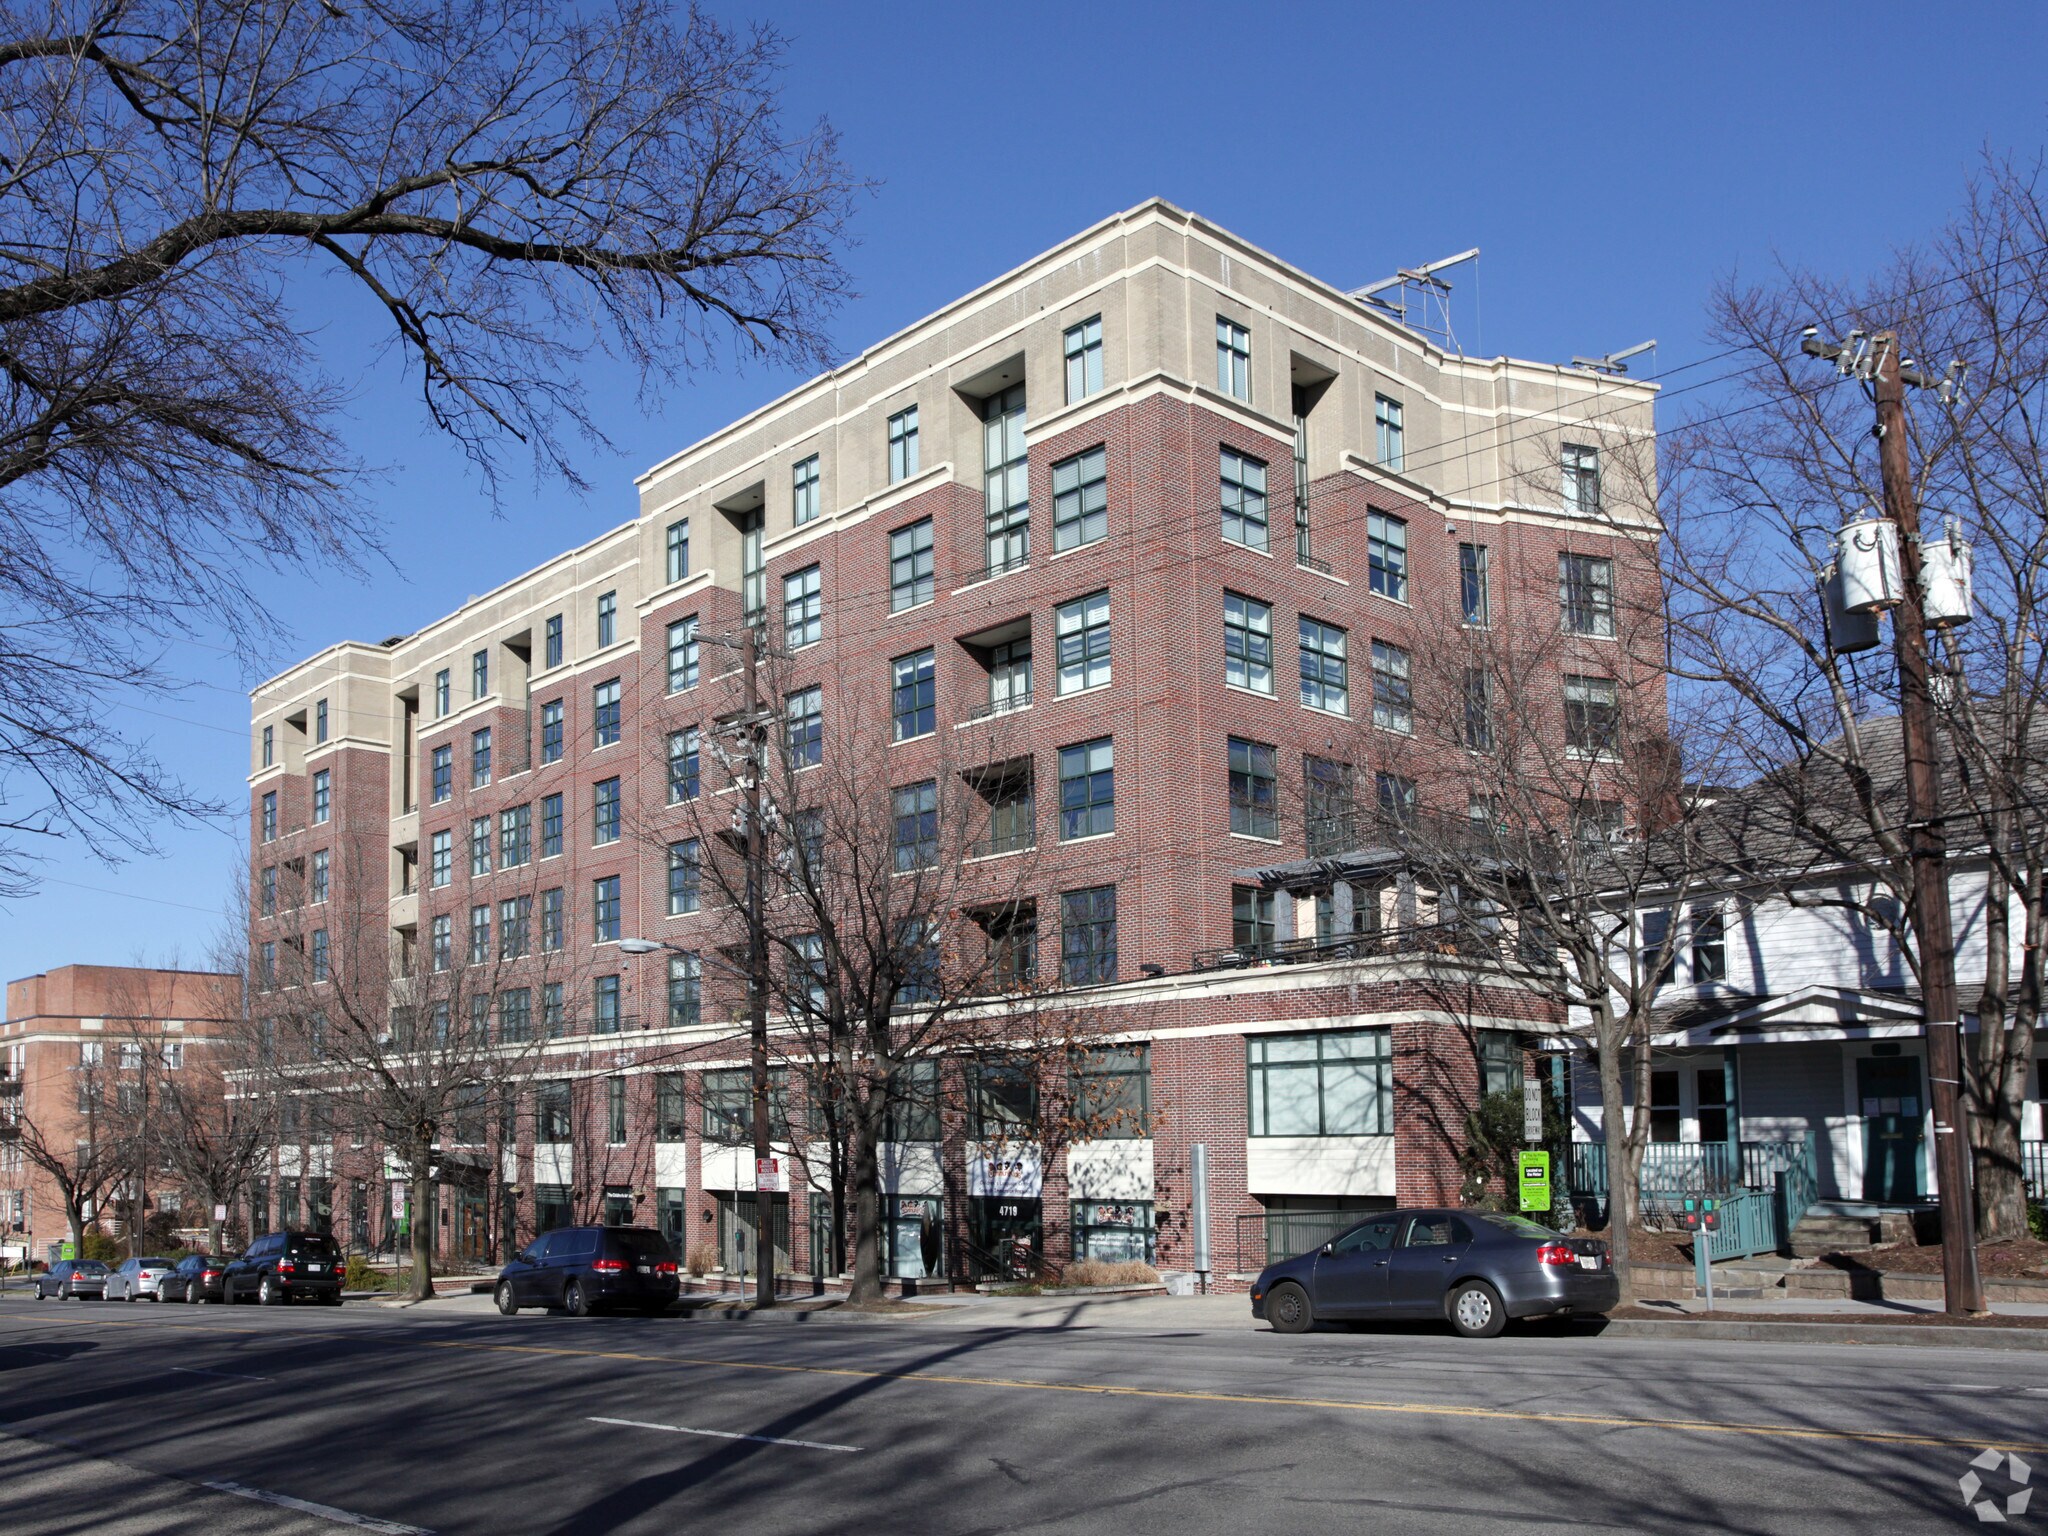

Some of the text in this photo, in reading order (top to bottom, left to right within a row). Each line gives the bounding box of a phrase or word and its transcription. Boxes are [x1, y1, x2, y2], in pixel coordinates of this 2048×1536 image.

[1525, 1087, 1541, 1101] DO NOT
[1526, 1107, 1541, 1121] BLOCK
[999, 1206, 1018, 1216] 4719
